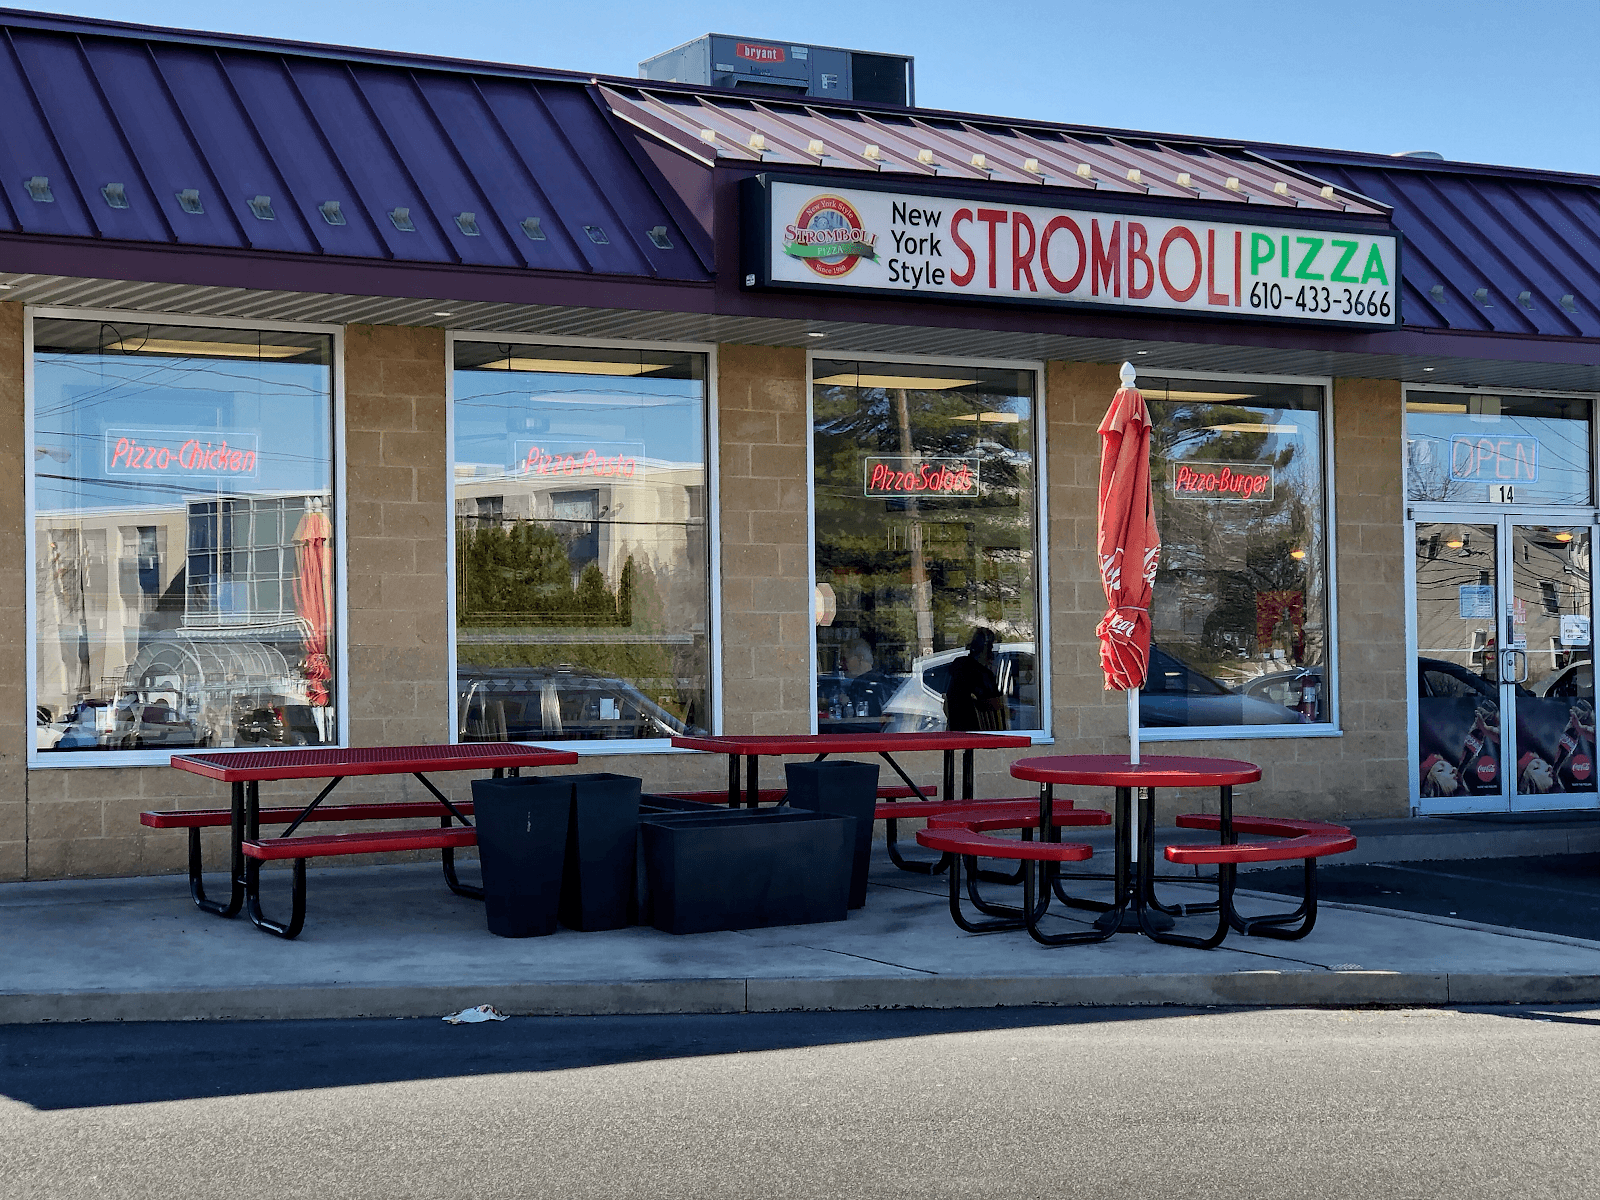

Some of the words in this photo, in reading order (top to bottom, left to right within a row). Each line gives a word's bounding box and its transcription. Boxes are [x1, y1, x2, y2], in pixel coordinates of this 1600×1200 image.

[744, 45, 777, 60] bryant
[805, 202, 820, 217] New
[820, 200, 837, 208] York
[837, 203, 854, 219] Style
[892, 201, 942, 227] New
[890, 230, 942, 256] York
[950, 207, 1242, 307] STROMBOLI
[815, 263, 832, 274] Since
[888, 258, 945, 289] Style
[1250, 232, 1389, 286] PIZZA
[1249, 281, 1391, 318] 610-433-3666
[111, 437, 256, 472] Pizza-Chicken
[524, 446, 635, 478] Pizza-Pasta
[1452, 438, 1536, 480] OPEN
[1175, 465, 1270, 499] Pizza-Burger
[1499, 485, 1515, 503] 14
